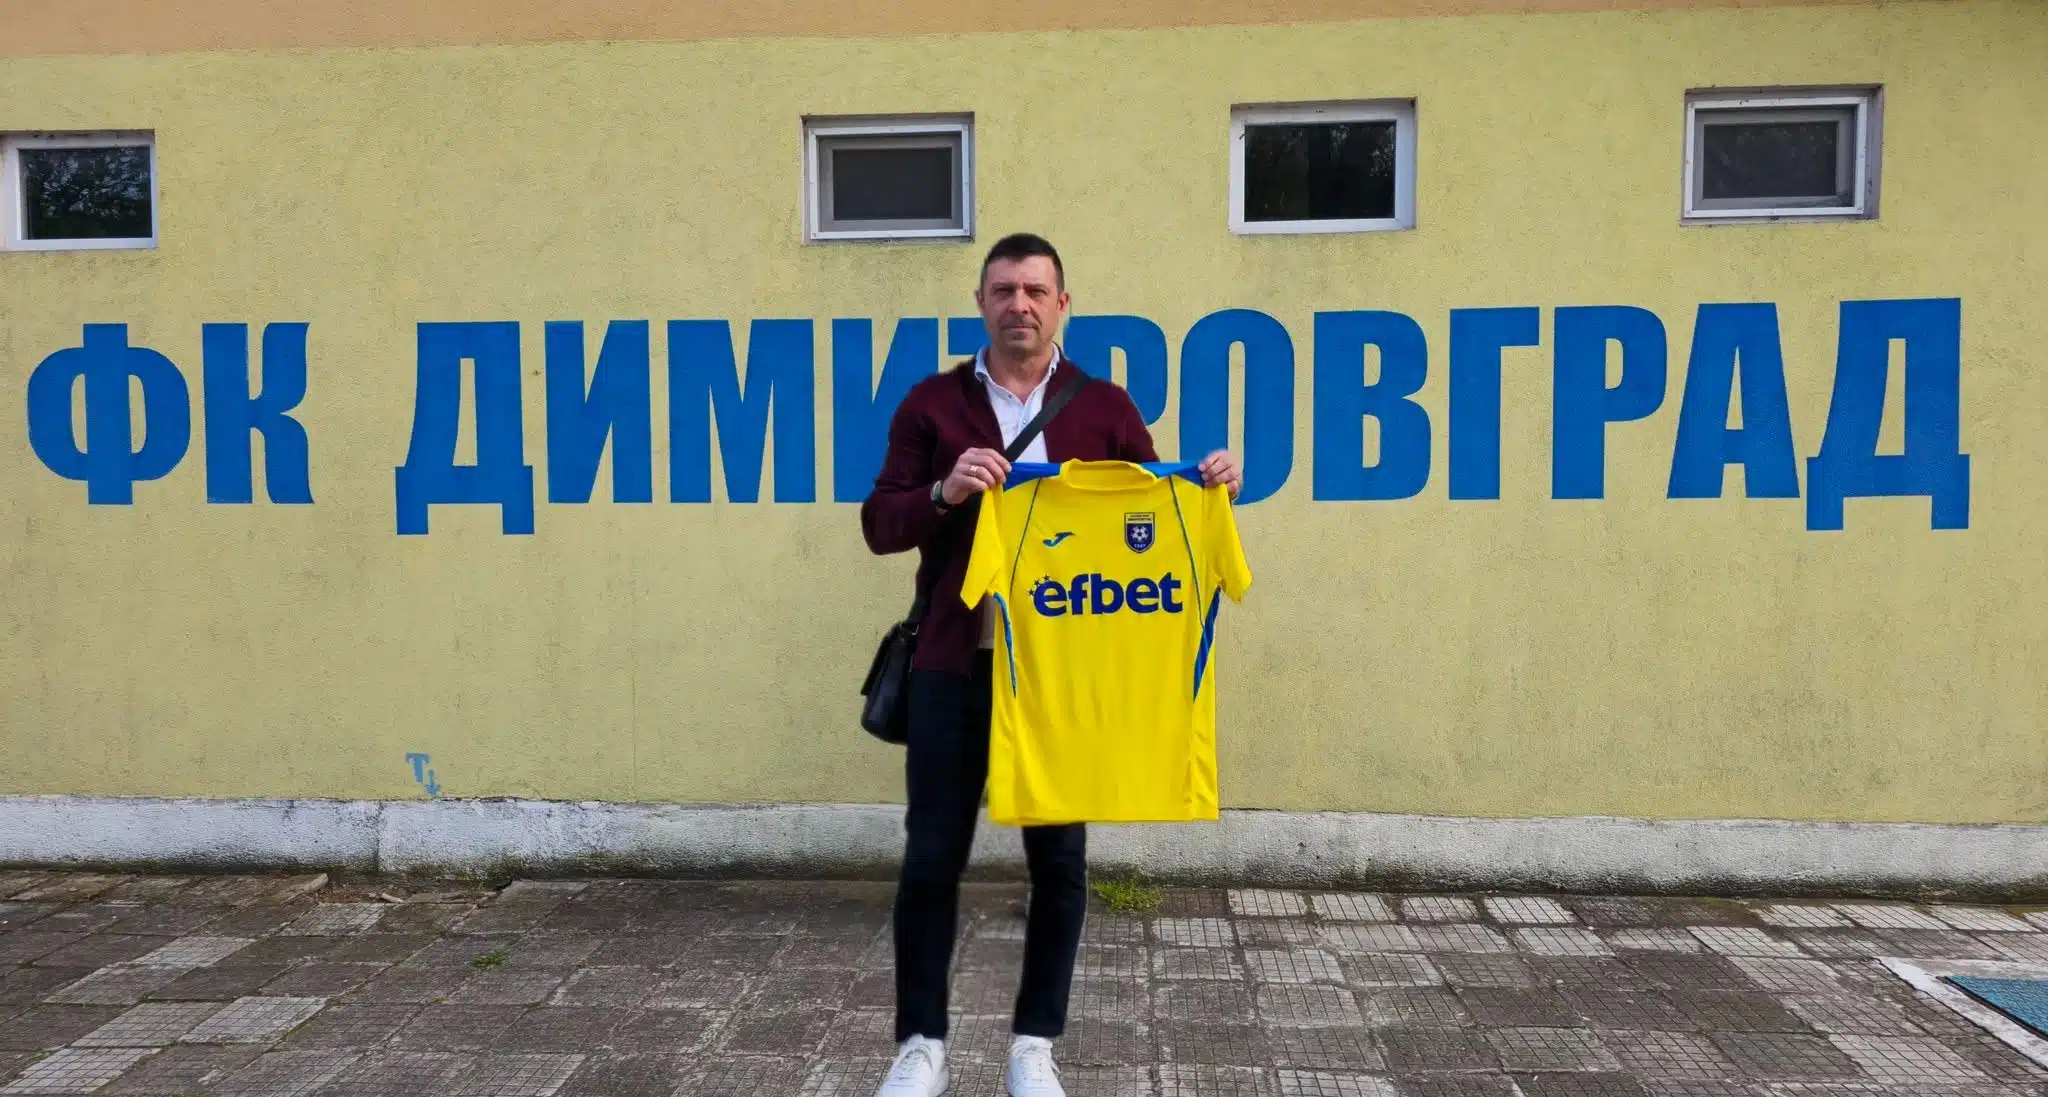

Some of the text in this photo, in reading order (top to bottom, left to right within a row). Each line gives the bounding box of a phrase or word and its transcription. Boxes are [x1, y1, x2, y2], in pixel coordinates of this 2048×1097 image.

[27, 297, 1971, 535] ФК ДИМИРОВГРАД
[1033, 572, 1183, 617] efbet
